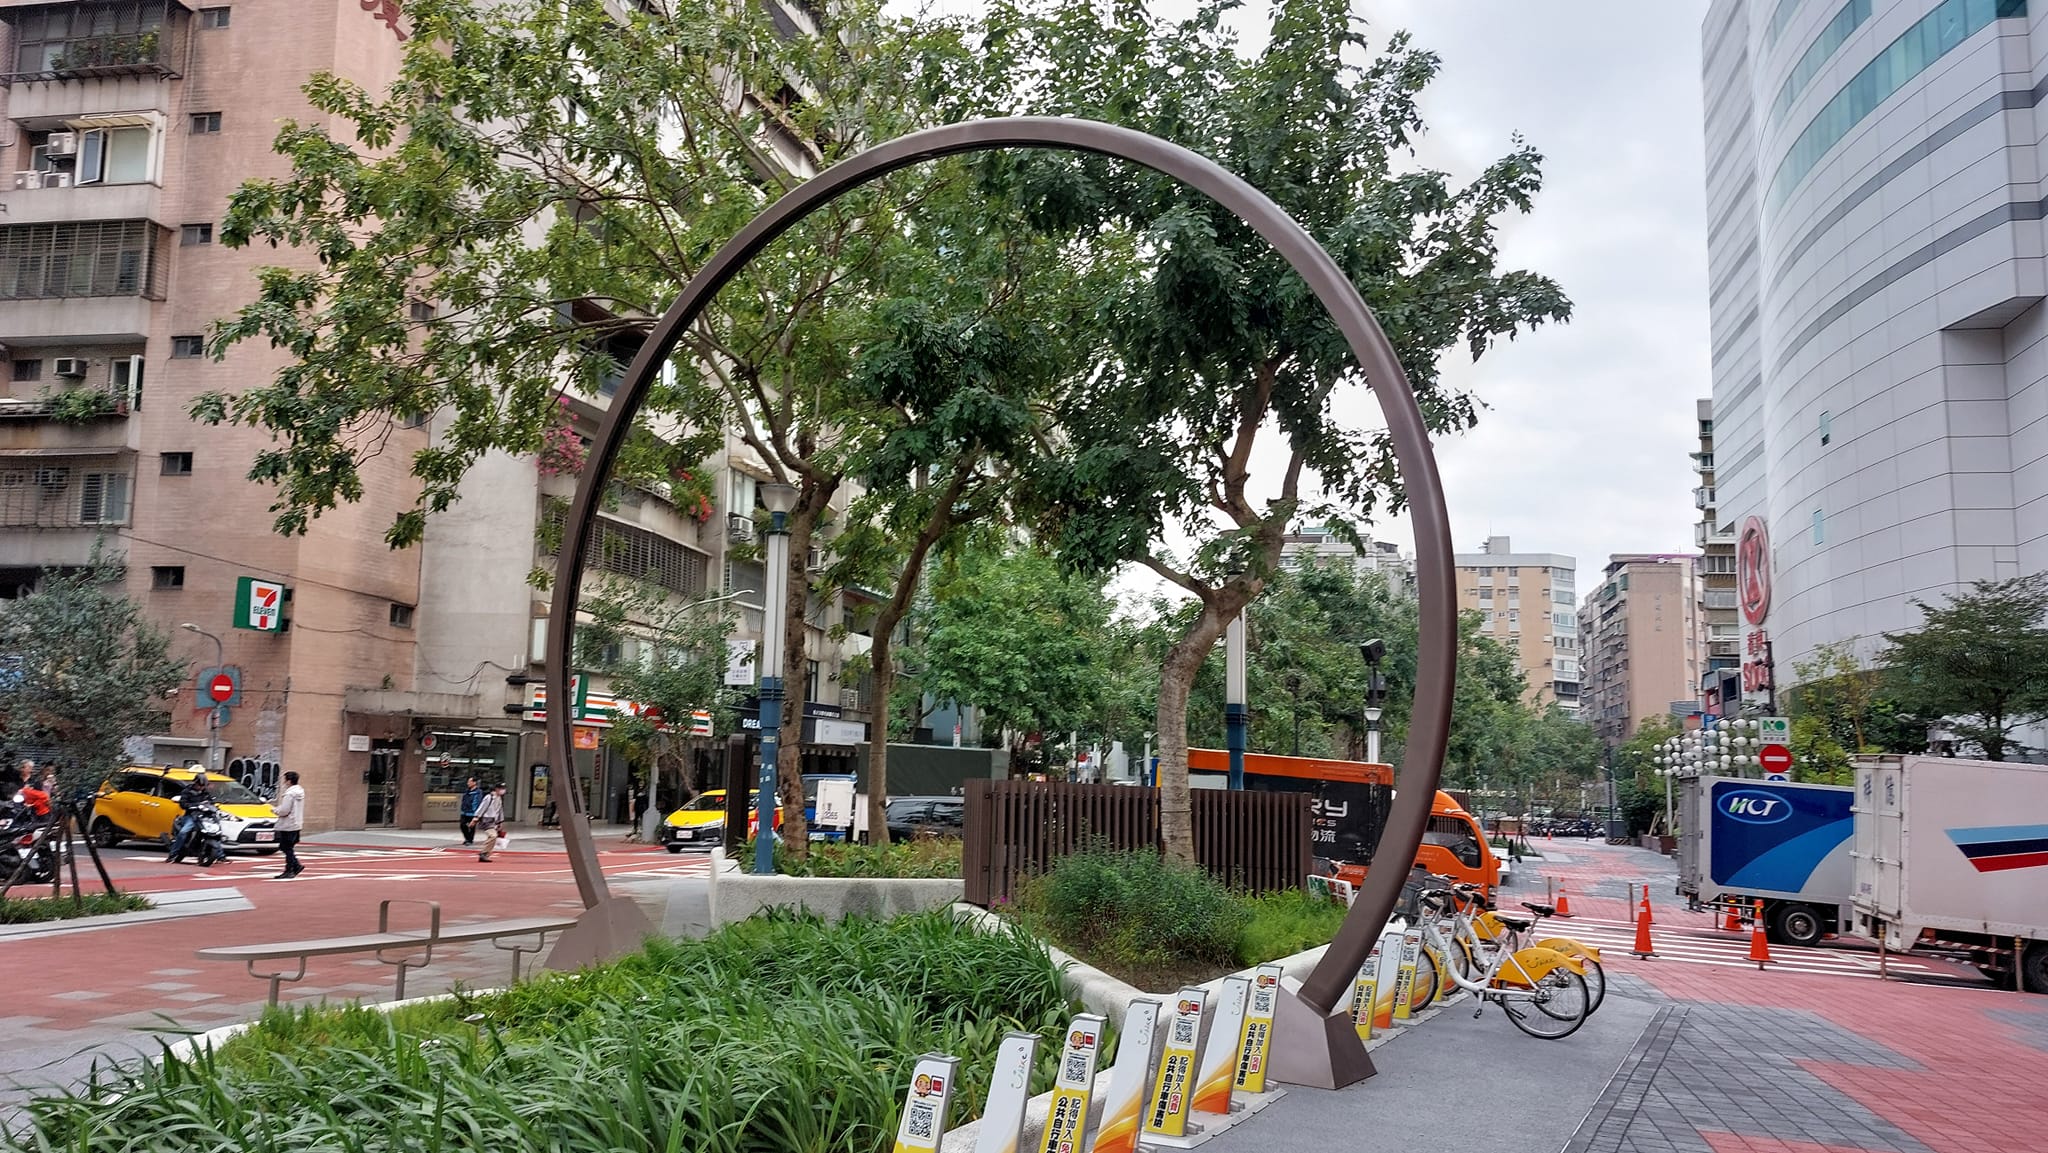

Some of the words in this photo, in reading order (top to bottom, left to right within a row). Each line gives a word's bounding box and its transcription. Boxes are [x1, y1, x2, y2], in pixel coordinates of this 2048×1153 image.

[256, 587, 278, 628] 7
[1172, 1056, 1189, 1092] 記得加入
[1063, 1098, 1081, 1140] 記得加入
[1169, 1093, 1180, 1111] 免費
[1046, 1096, 1068, 1153] 公共自行車
